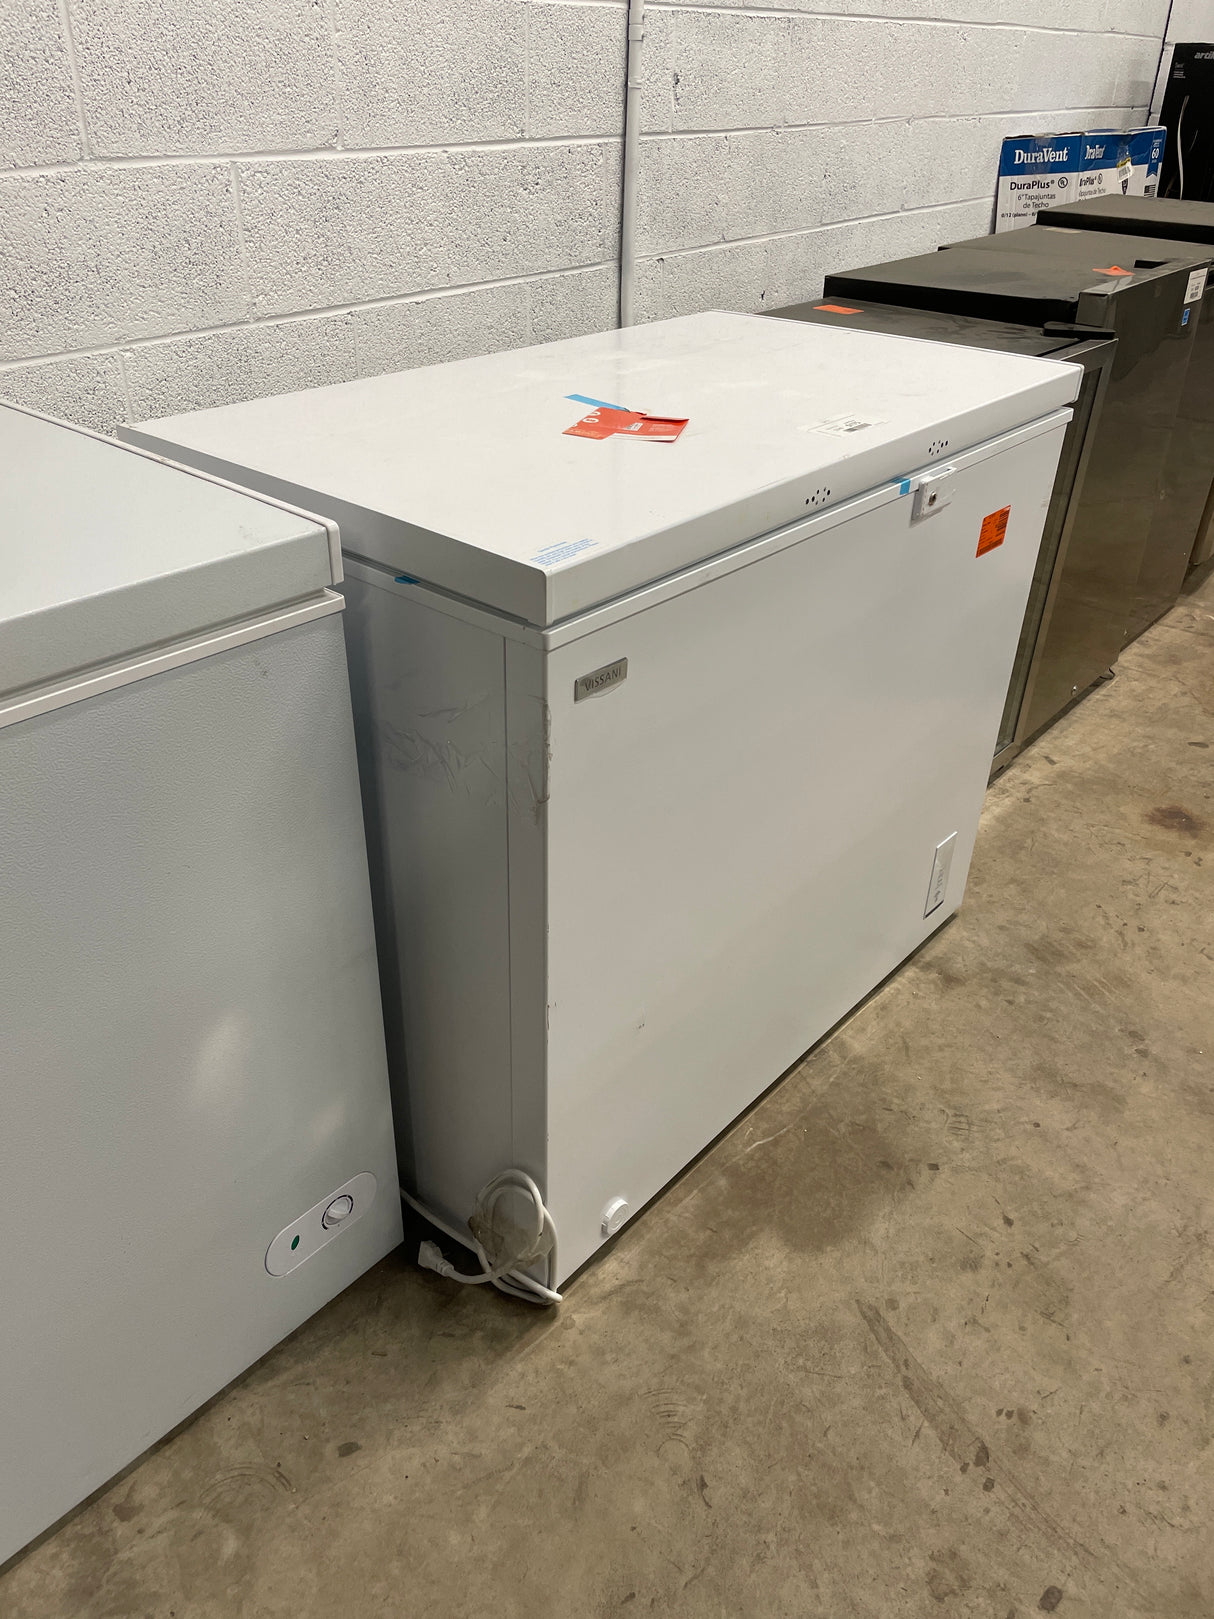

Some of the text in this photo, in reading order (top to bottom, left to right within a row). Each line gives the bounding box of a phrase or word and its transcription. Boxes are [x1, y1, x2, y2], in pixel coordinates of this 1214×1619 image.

[1013, 147, 1069, 165] DuraVent
[1151, 148, 1160, 159] 60
[584, 667, 621, 692] VISSANI
